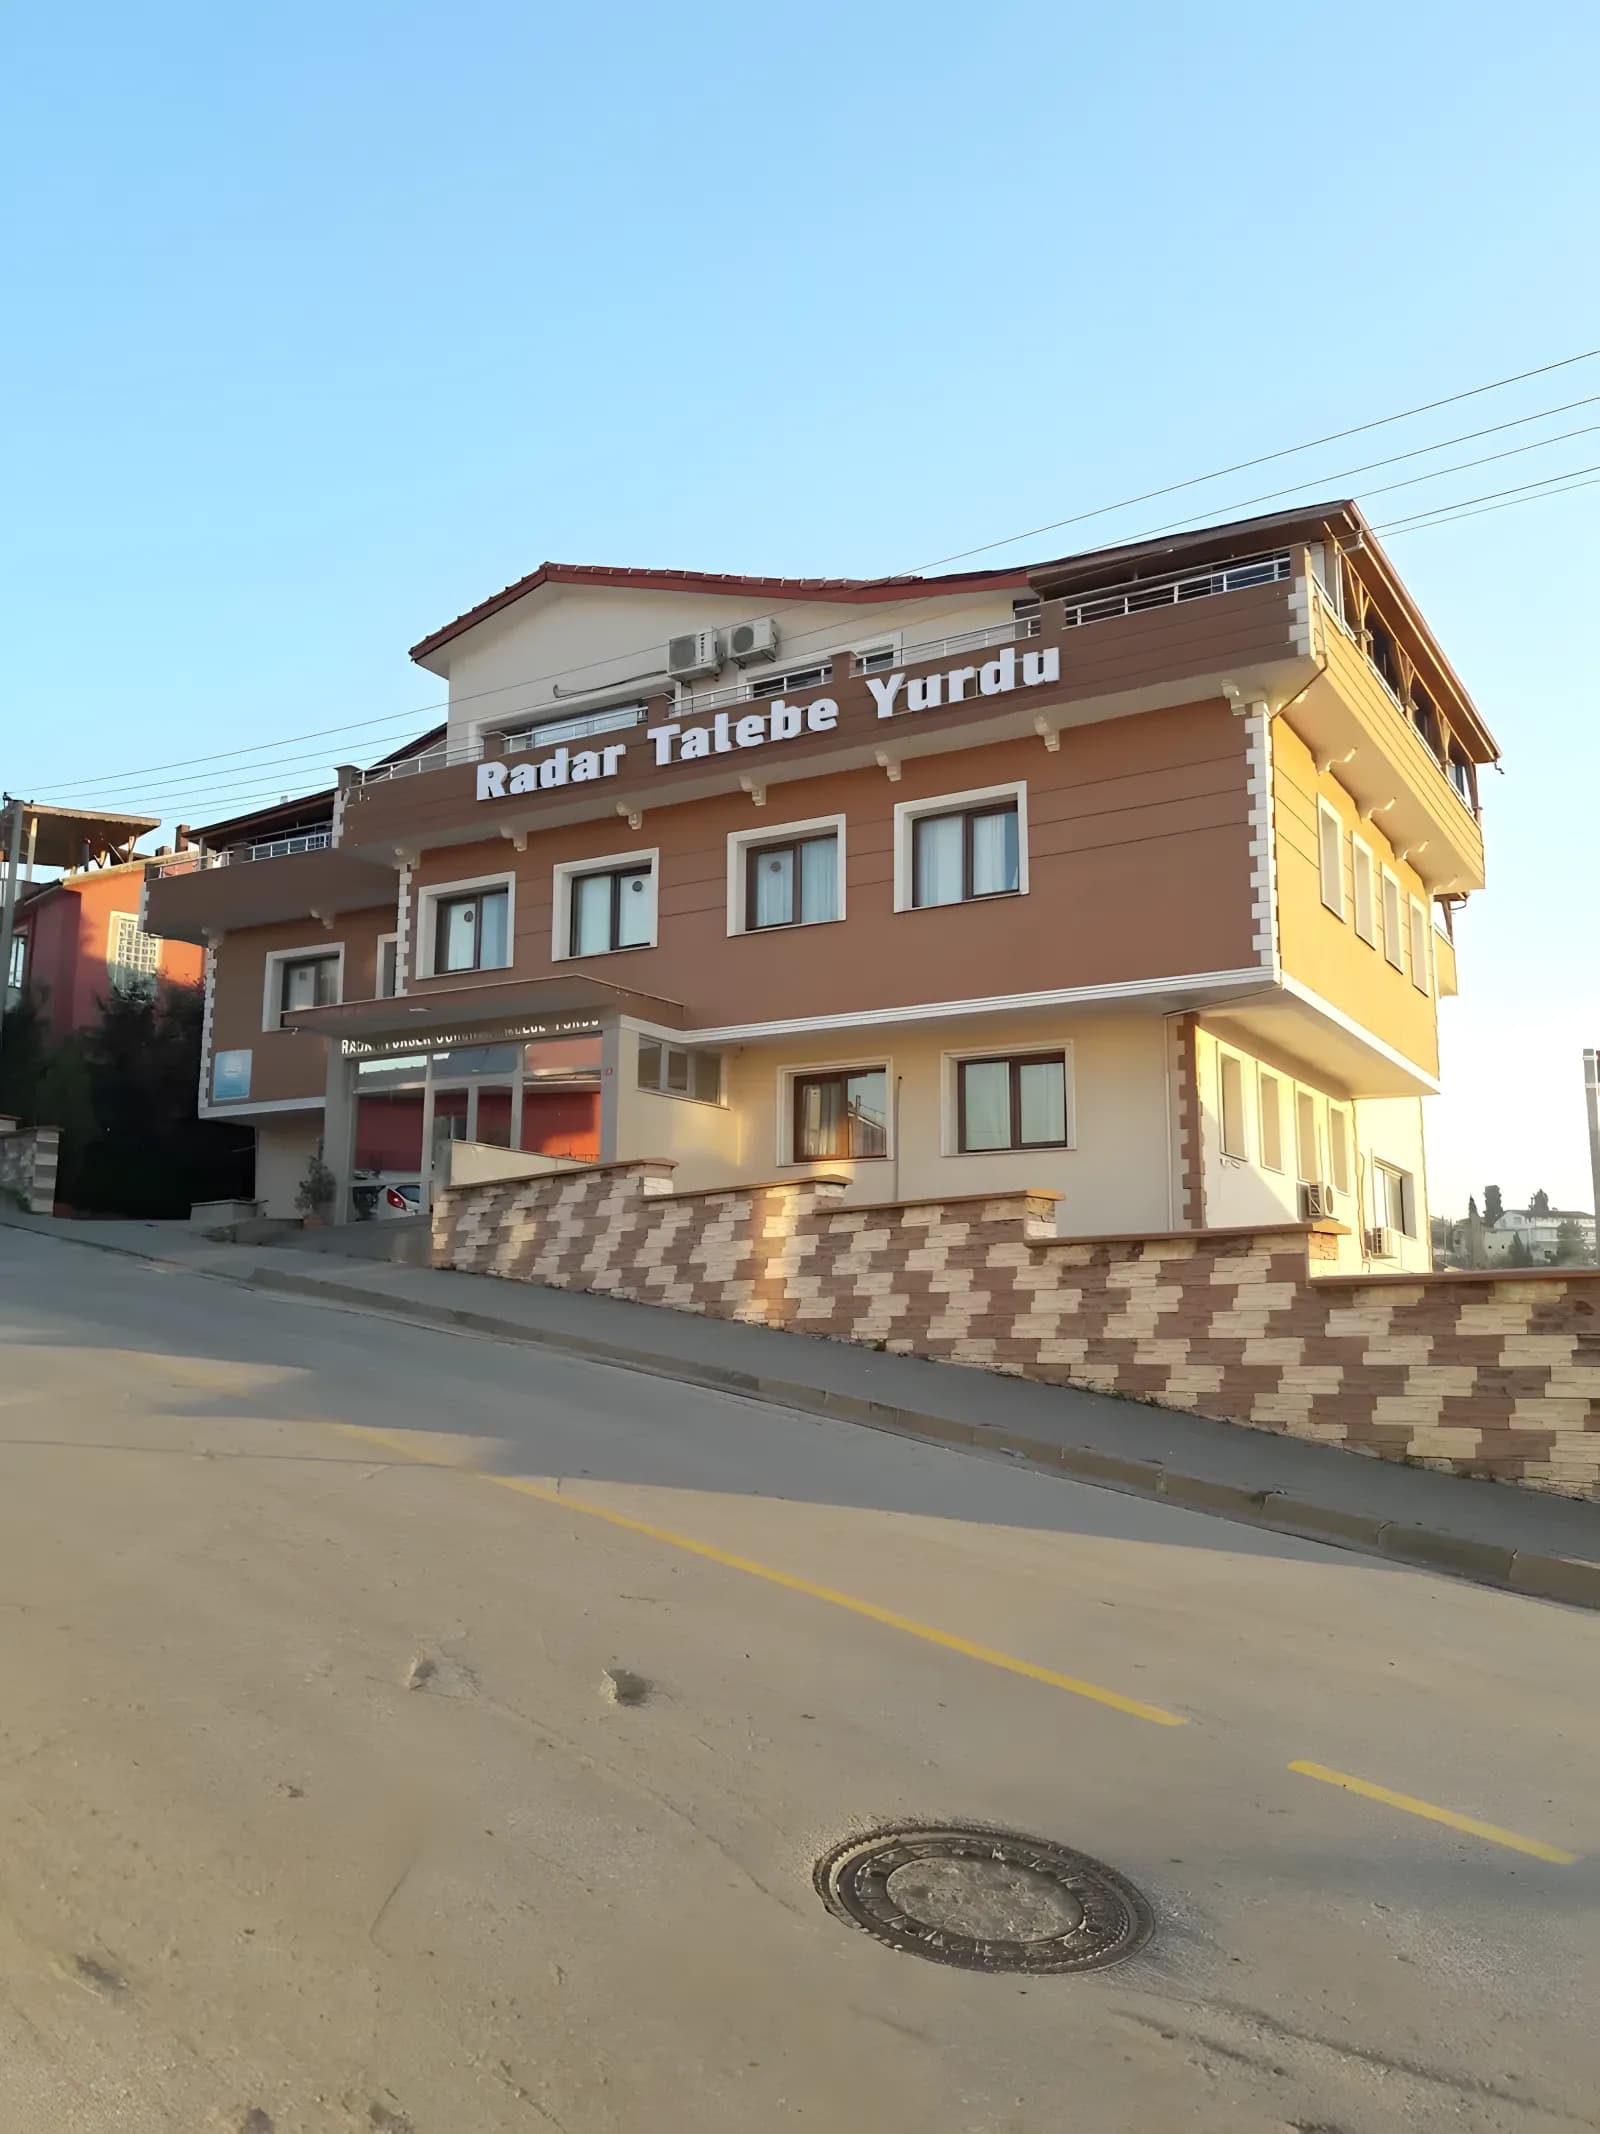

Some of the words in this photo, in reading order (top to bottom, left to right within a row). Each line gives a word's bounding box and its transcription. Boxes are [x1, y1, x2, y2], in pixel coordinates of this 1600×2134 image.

[476, 744, 626, 801] Radar
[647, 698, 840, 766] Talebe
[865, 647, 1061, 719] Yurdu
